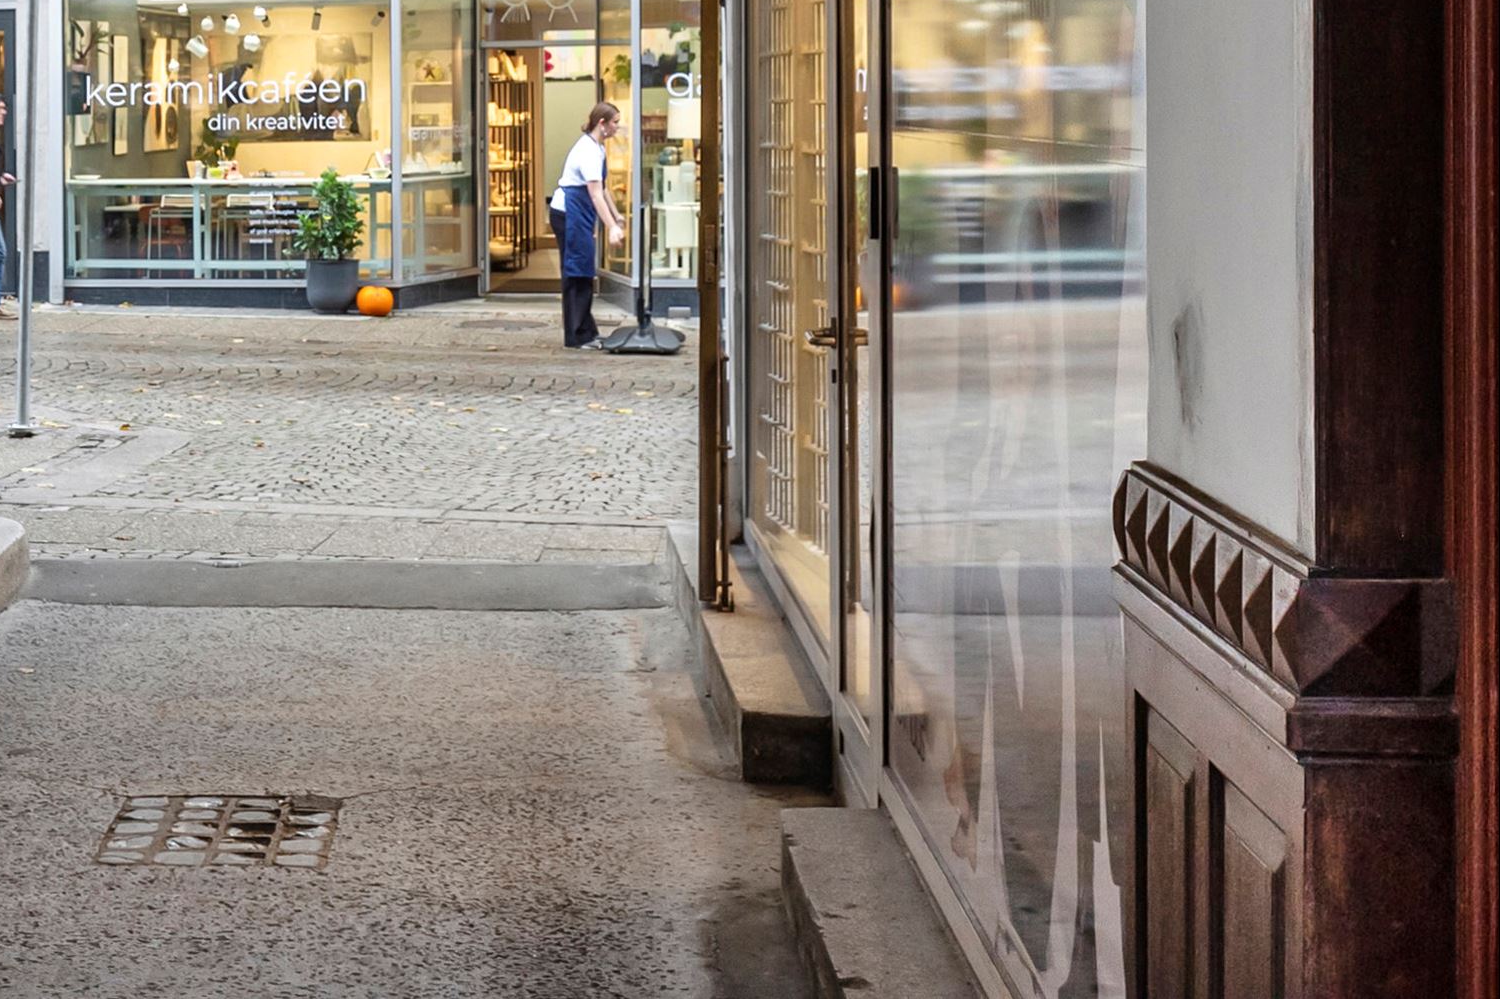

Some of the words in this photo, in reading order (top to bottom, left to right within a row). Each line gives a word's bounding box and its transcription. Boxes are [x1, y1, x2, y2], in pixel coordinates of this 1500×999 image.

[84, 73, 367, 107] keramikcaféen
[207, 112, 240, 132] din
[246, 114, 346, 132] kreativitet
